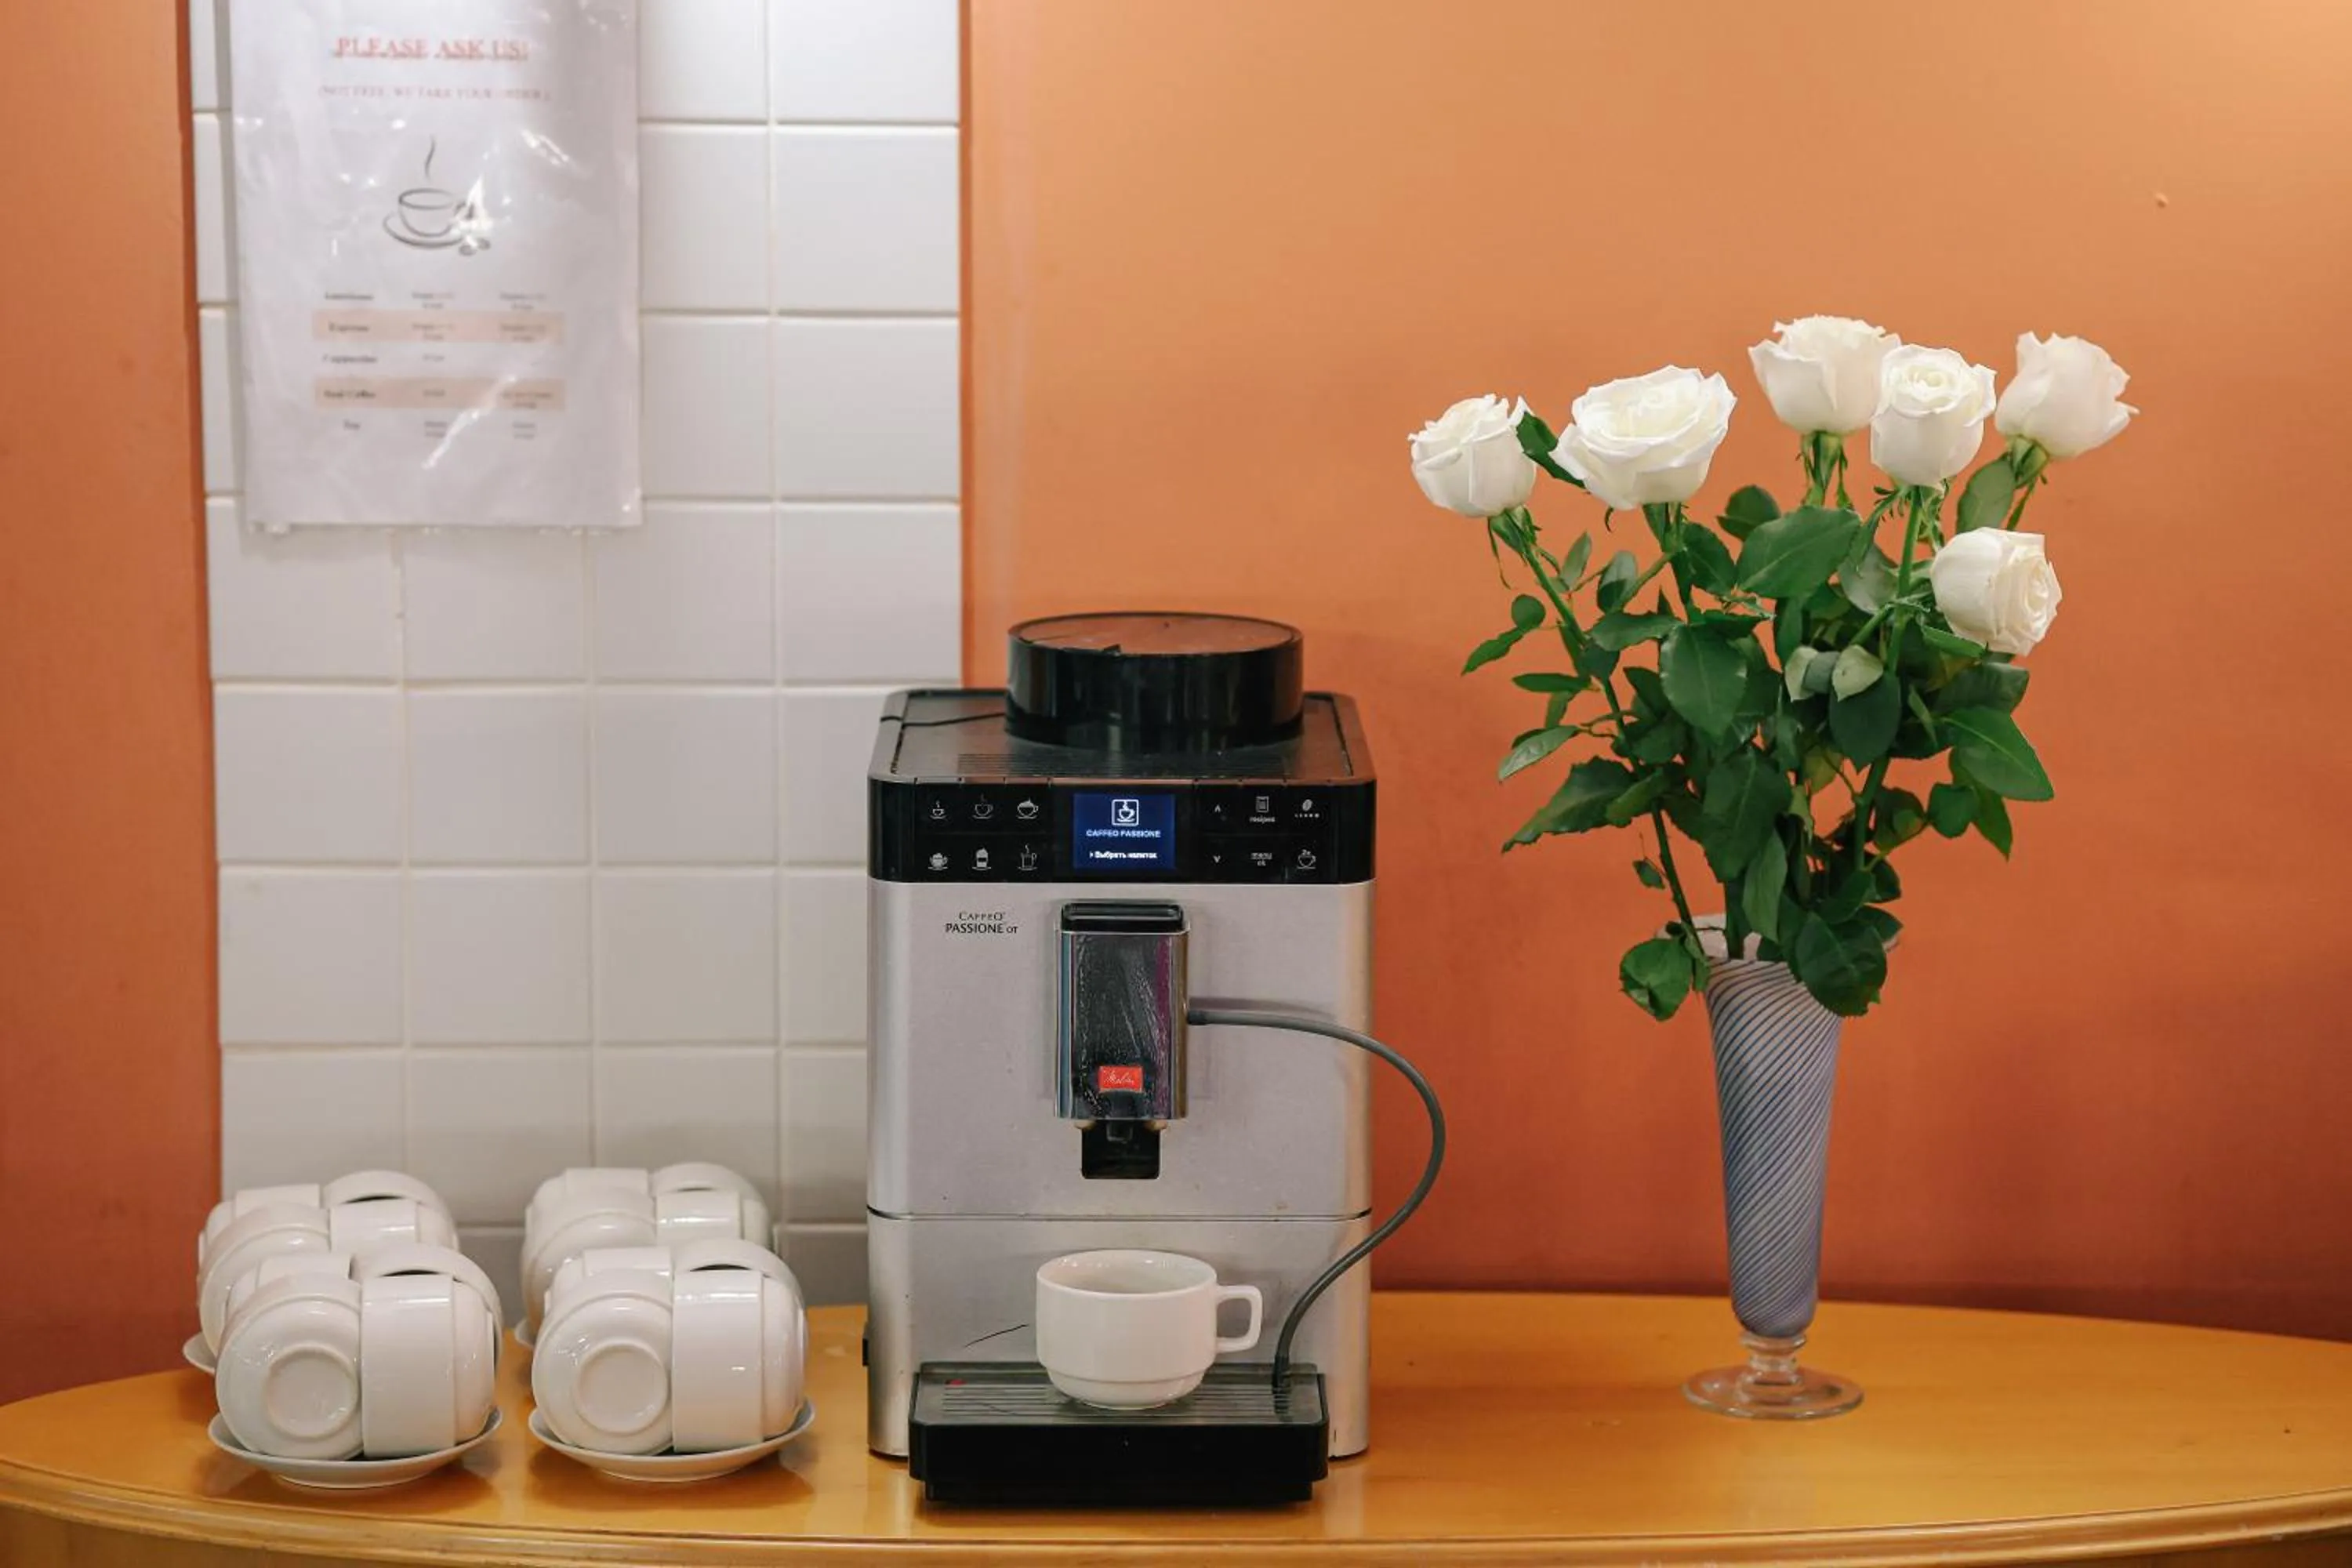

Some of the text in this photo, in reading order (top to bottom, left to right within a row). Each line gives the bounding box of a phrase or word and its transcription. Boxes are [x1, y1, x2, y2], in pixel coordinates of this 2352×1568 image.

[334, 37, 428, 59] PLEASE
[434, 38, 485, 59] ASK
[1085, 829, 1161, 838] CAFFEO PASSIONE
[945, 923, 1004, 934] PASSIONE
